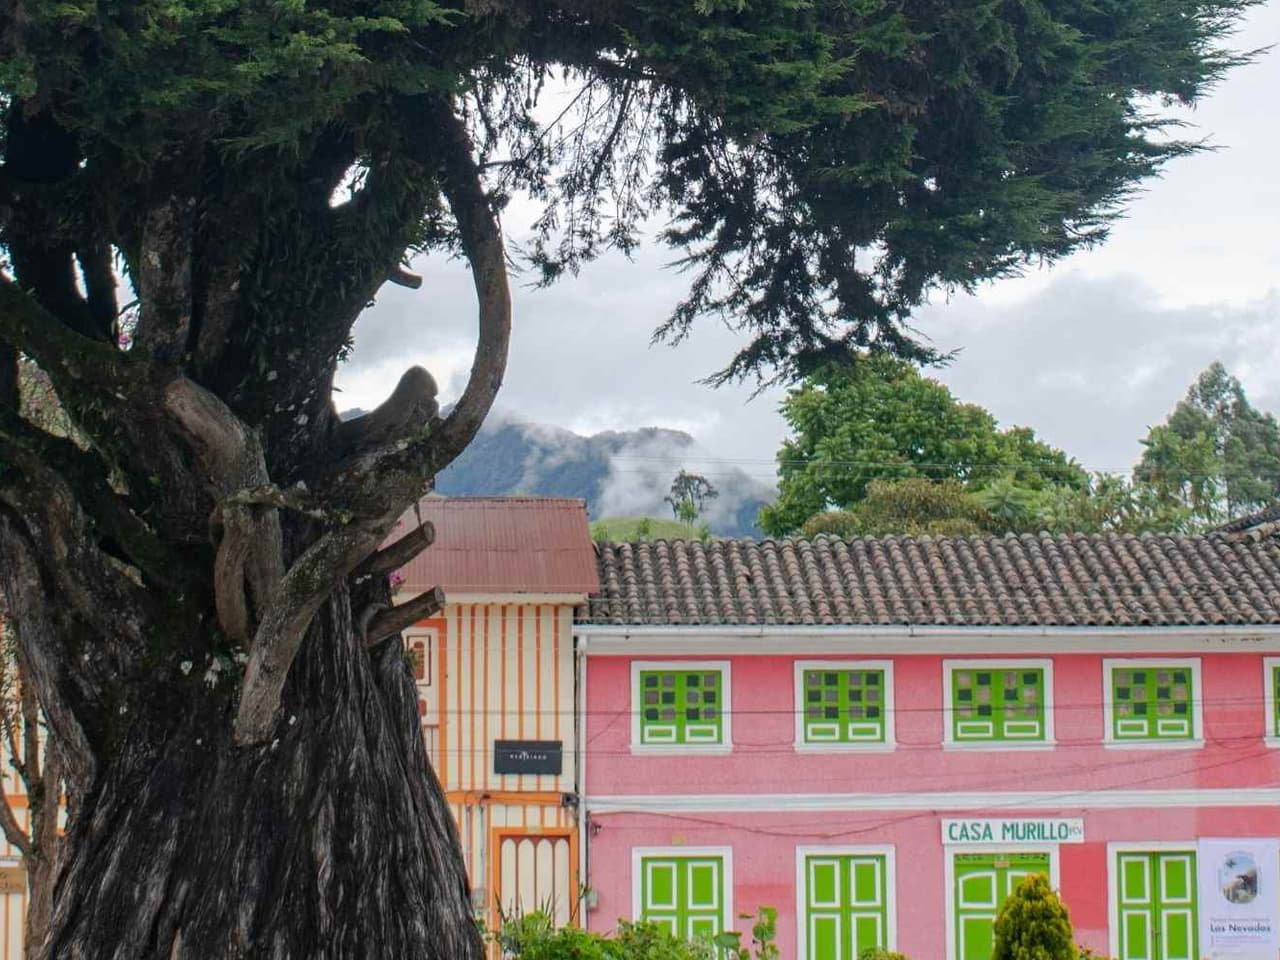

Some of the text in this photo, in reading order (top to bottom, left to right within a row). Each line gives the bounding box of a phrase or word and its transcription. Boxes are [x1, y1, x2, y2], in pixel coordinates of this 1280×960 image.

[948, 822, 994, 841] CASA
[1002, 822, 1069, 841] MURILLO
[1210, 922, 1272, 933] Los Nevados
